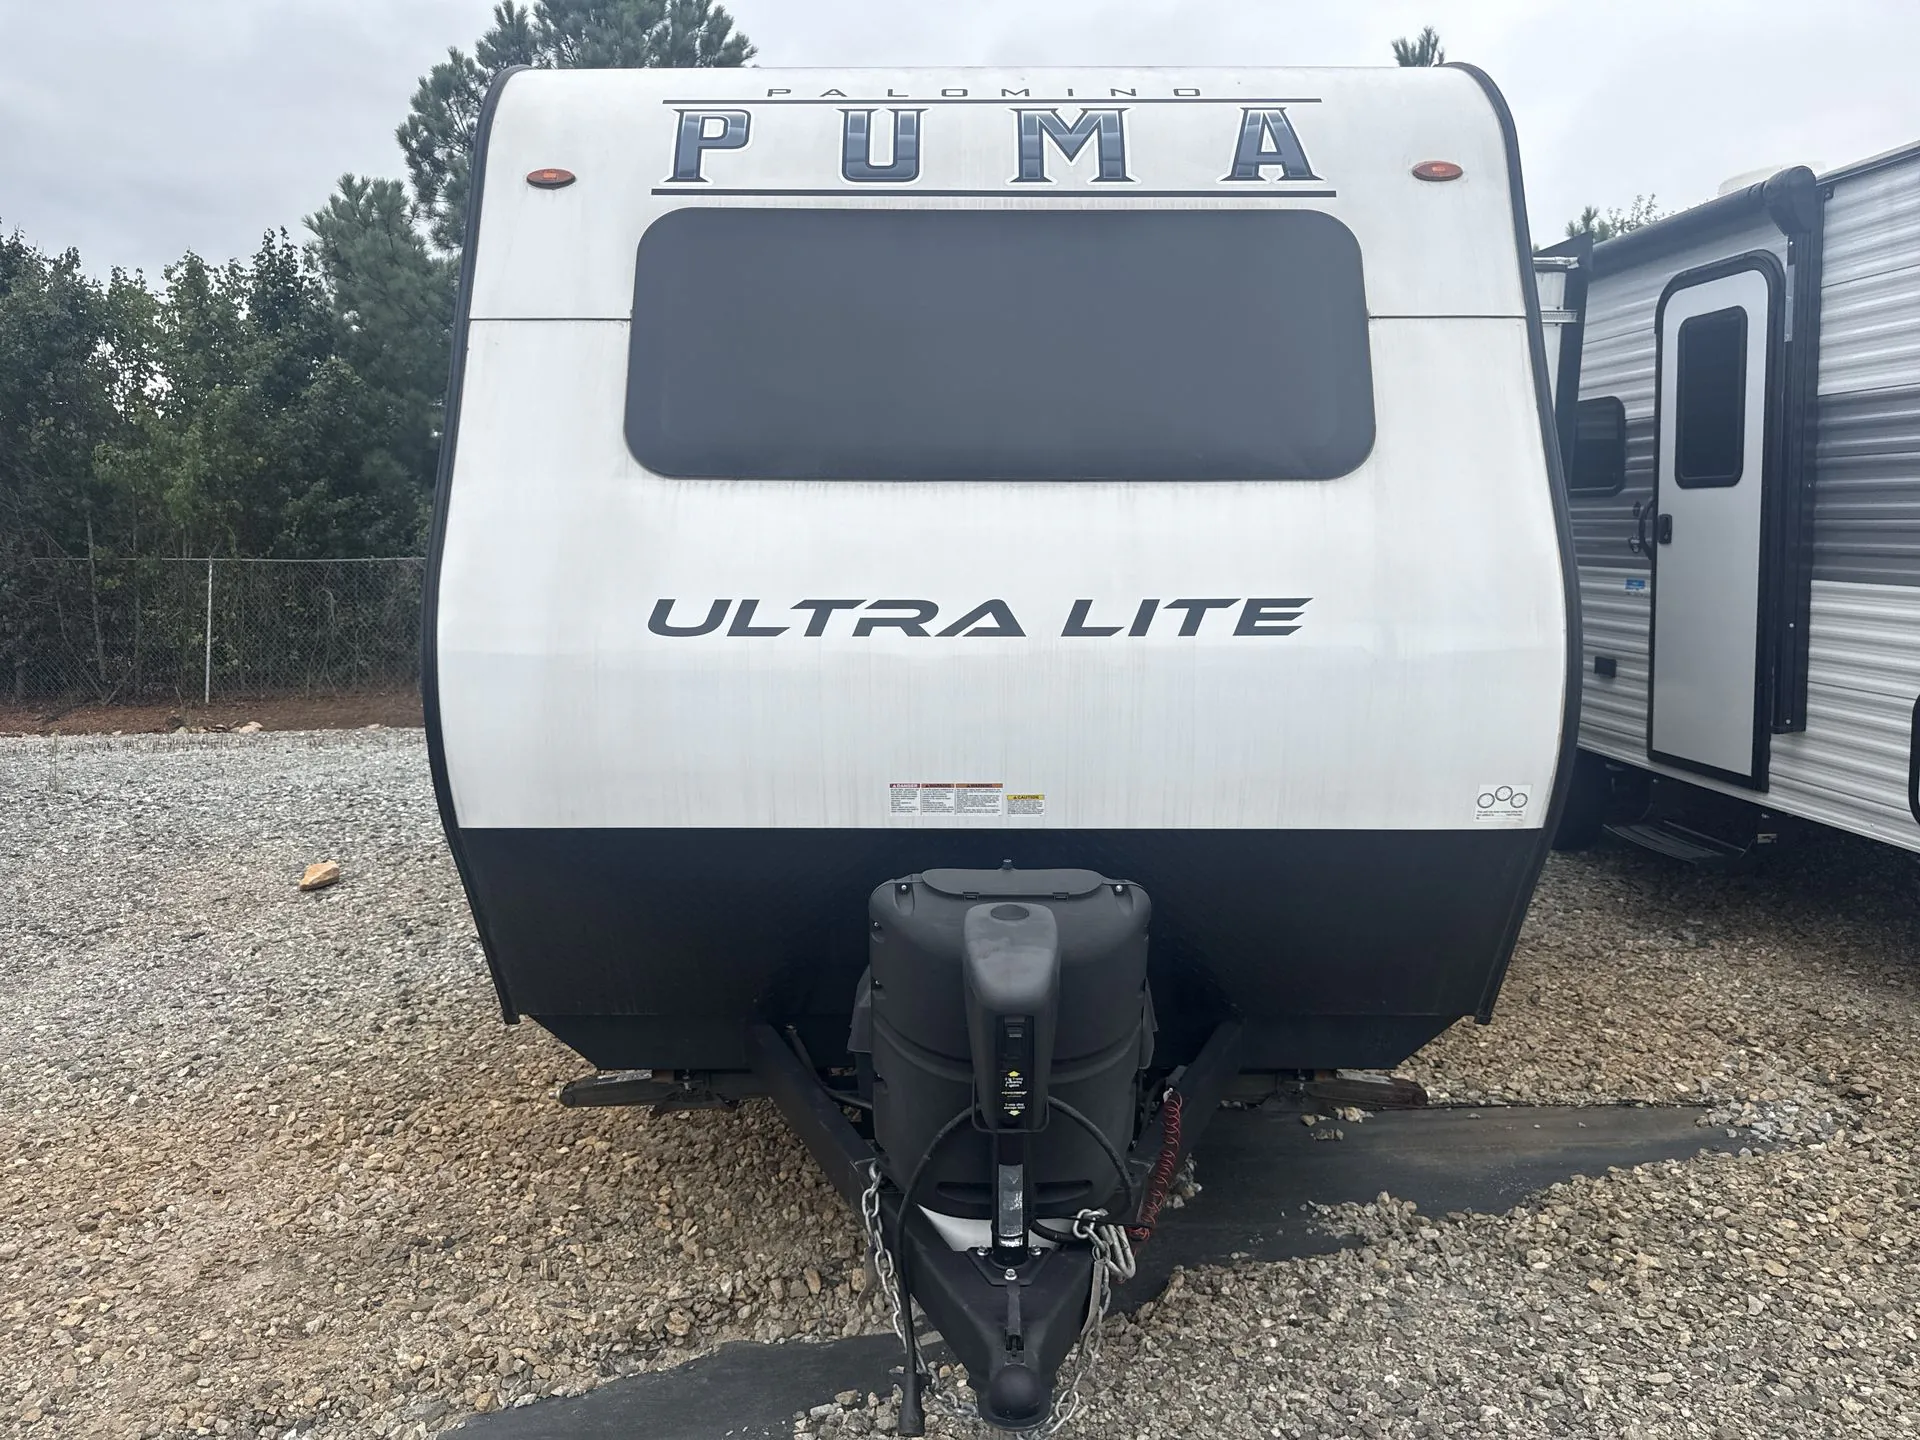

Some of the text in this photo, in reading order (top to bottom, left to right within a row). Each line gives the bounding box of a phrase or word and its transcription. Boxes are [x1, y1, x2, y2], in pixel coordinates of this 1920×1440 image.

[767, 88, 1203, 98] PALOMINO
[666, 108, 1320, 183] PUMA
[647, 596, 1314, 638] ULTRA LITE
